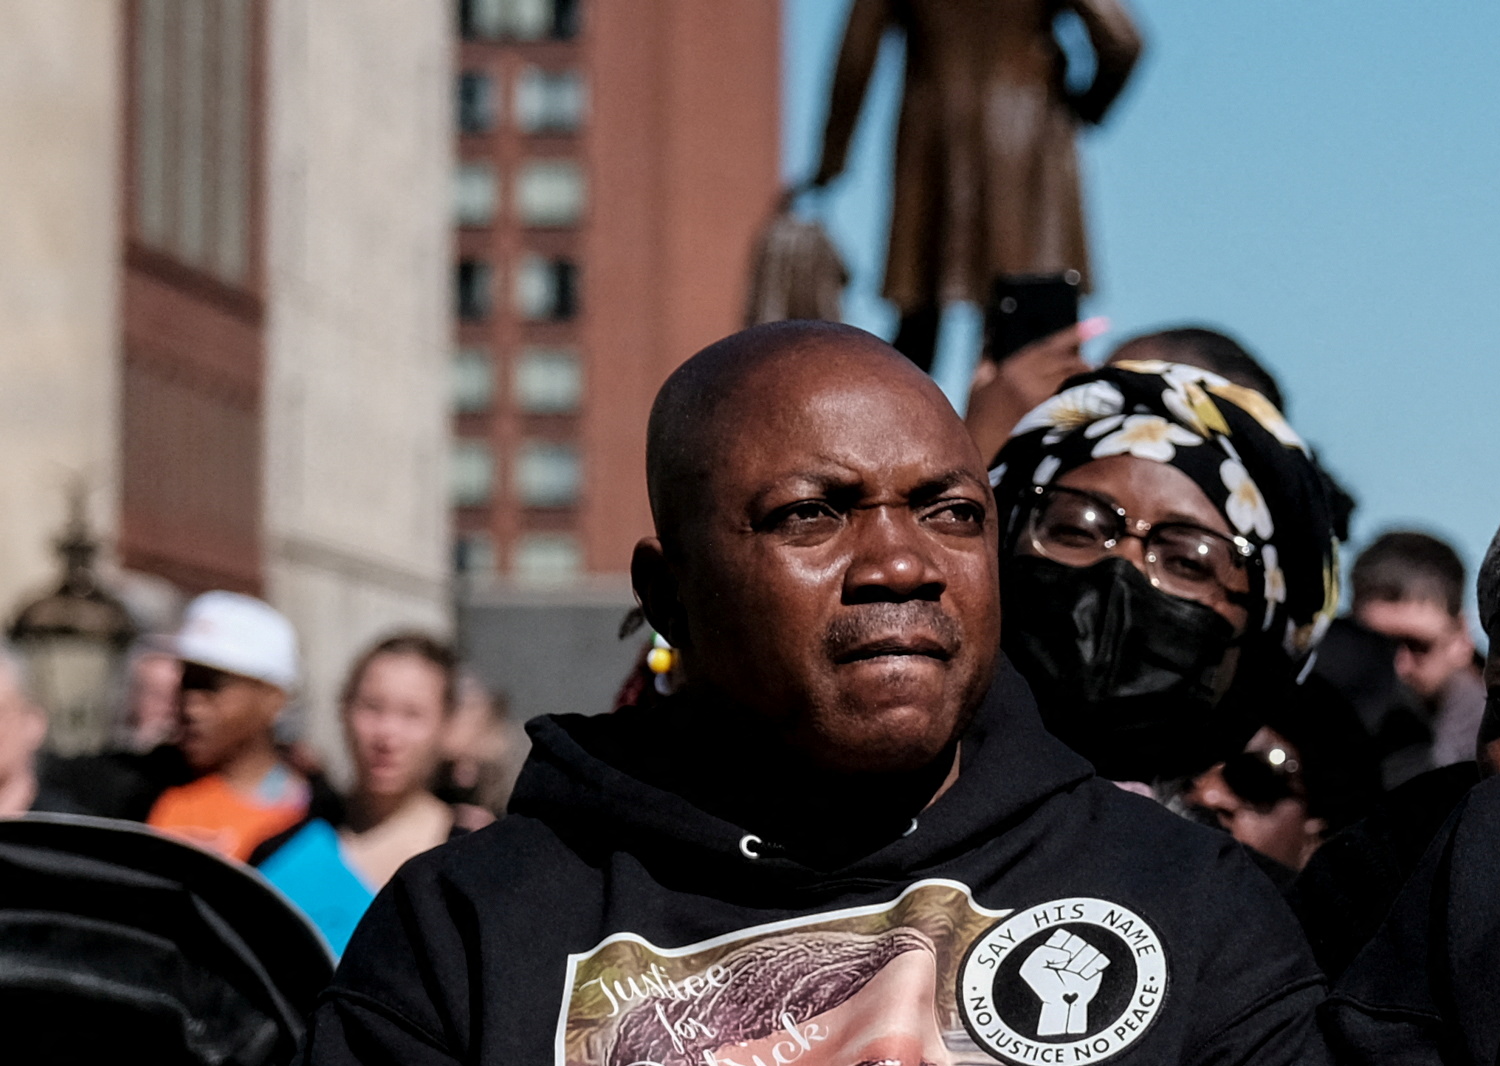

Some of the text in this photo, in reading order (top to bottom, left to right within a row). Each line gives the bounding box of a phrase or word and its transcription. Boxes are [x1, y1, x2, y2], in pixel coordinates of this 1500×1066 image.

[977, 903, 1157, 969] SAY HIS NAME
[579, 962, 733, 1018] Justice
[655, 1002, 719, 1055] for
[970, 984, 1160, 1063] NO JUSTICE NO PEACE
